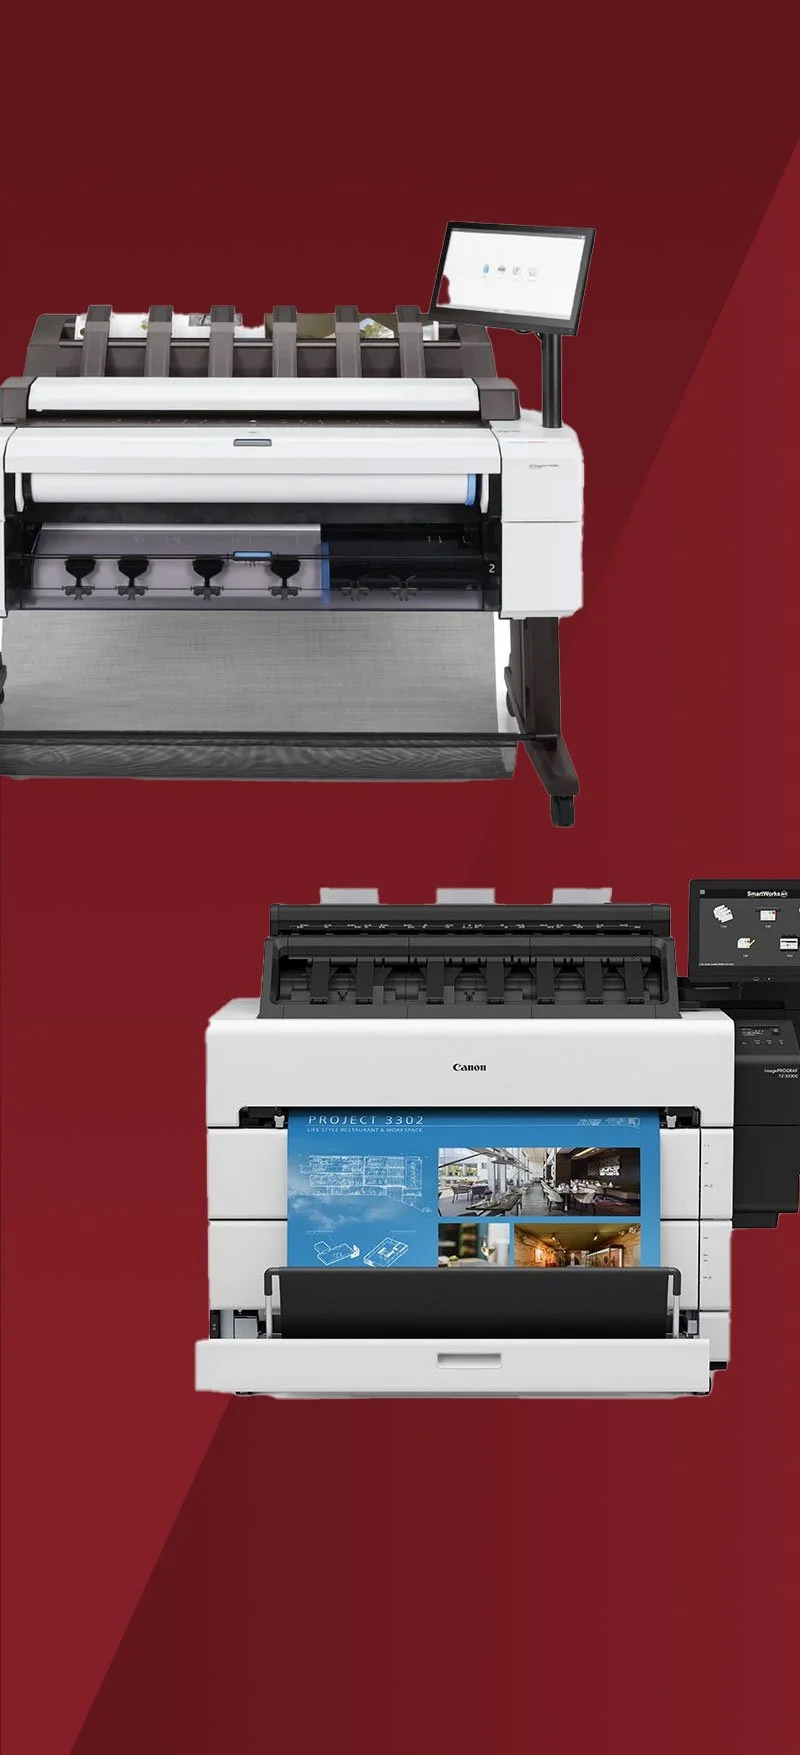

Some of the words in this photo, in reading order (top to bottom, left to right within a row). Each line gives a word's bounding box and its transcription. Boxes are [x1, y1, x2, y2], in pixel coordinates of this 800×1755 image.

[488, 563, 496, 573] 2
[452, 1063, 487, 1072] Canon
[308, 1115, 377, 1125] PROJECT
[385, 1115, 424, 1125] 3302
